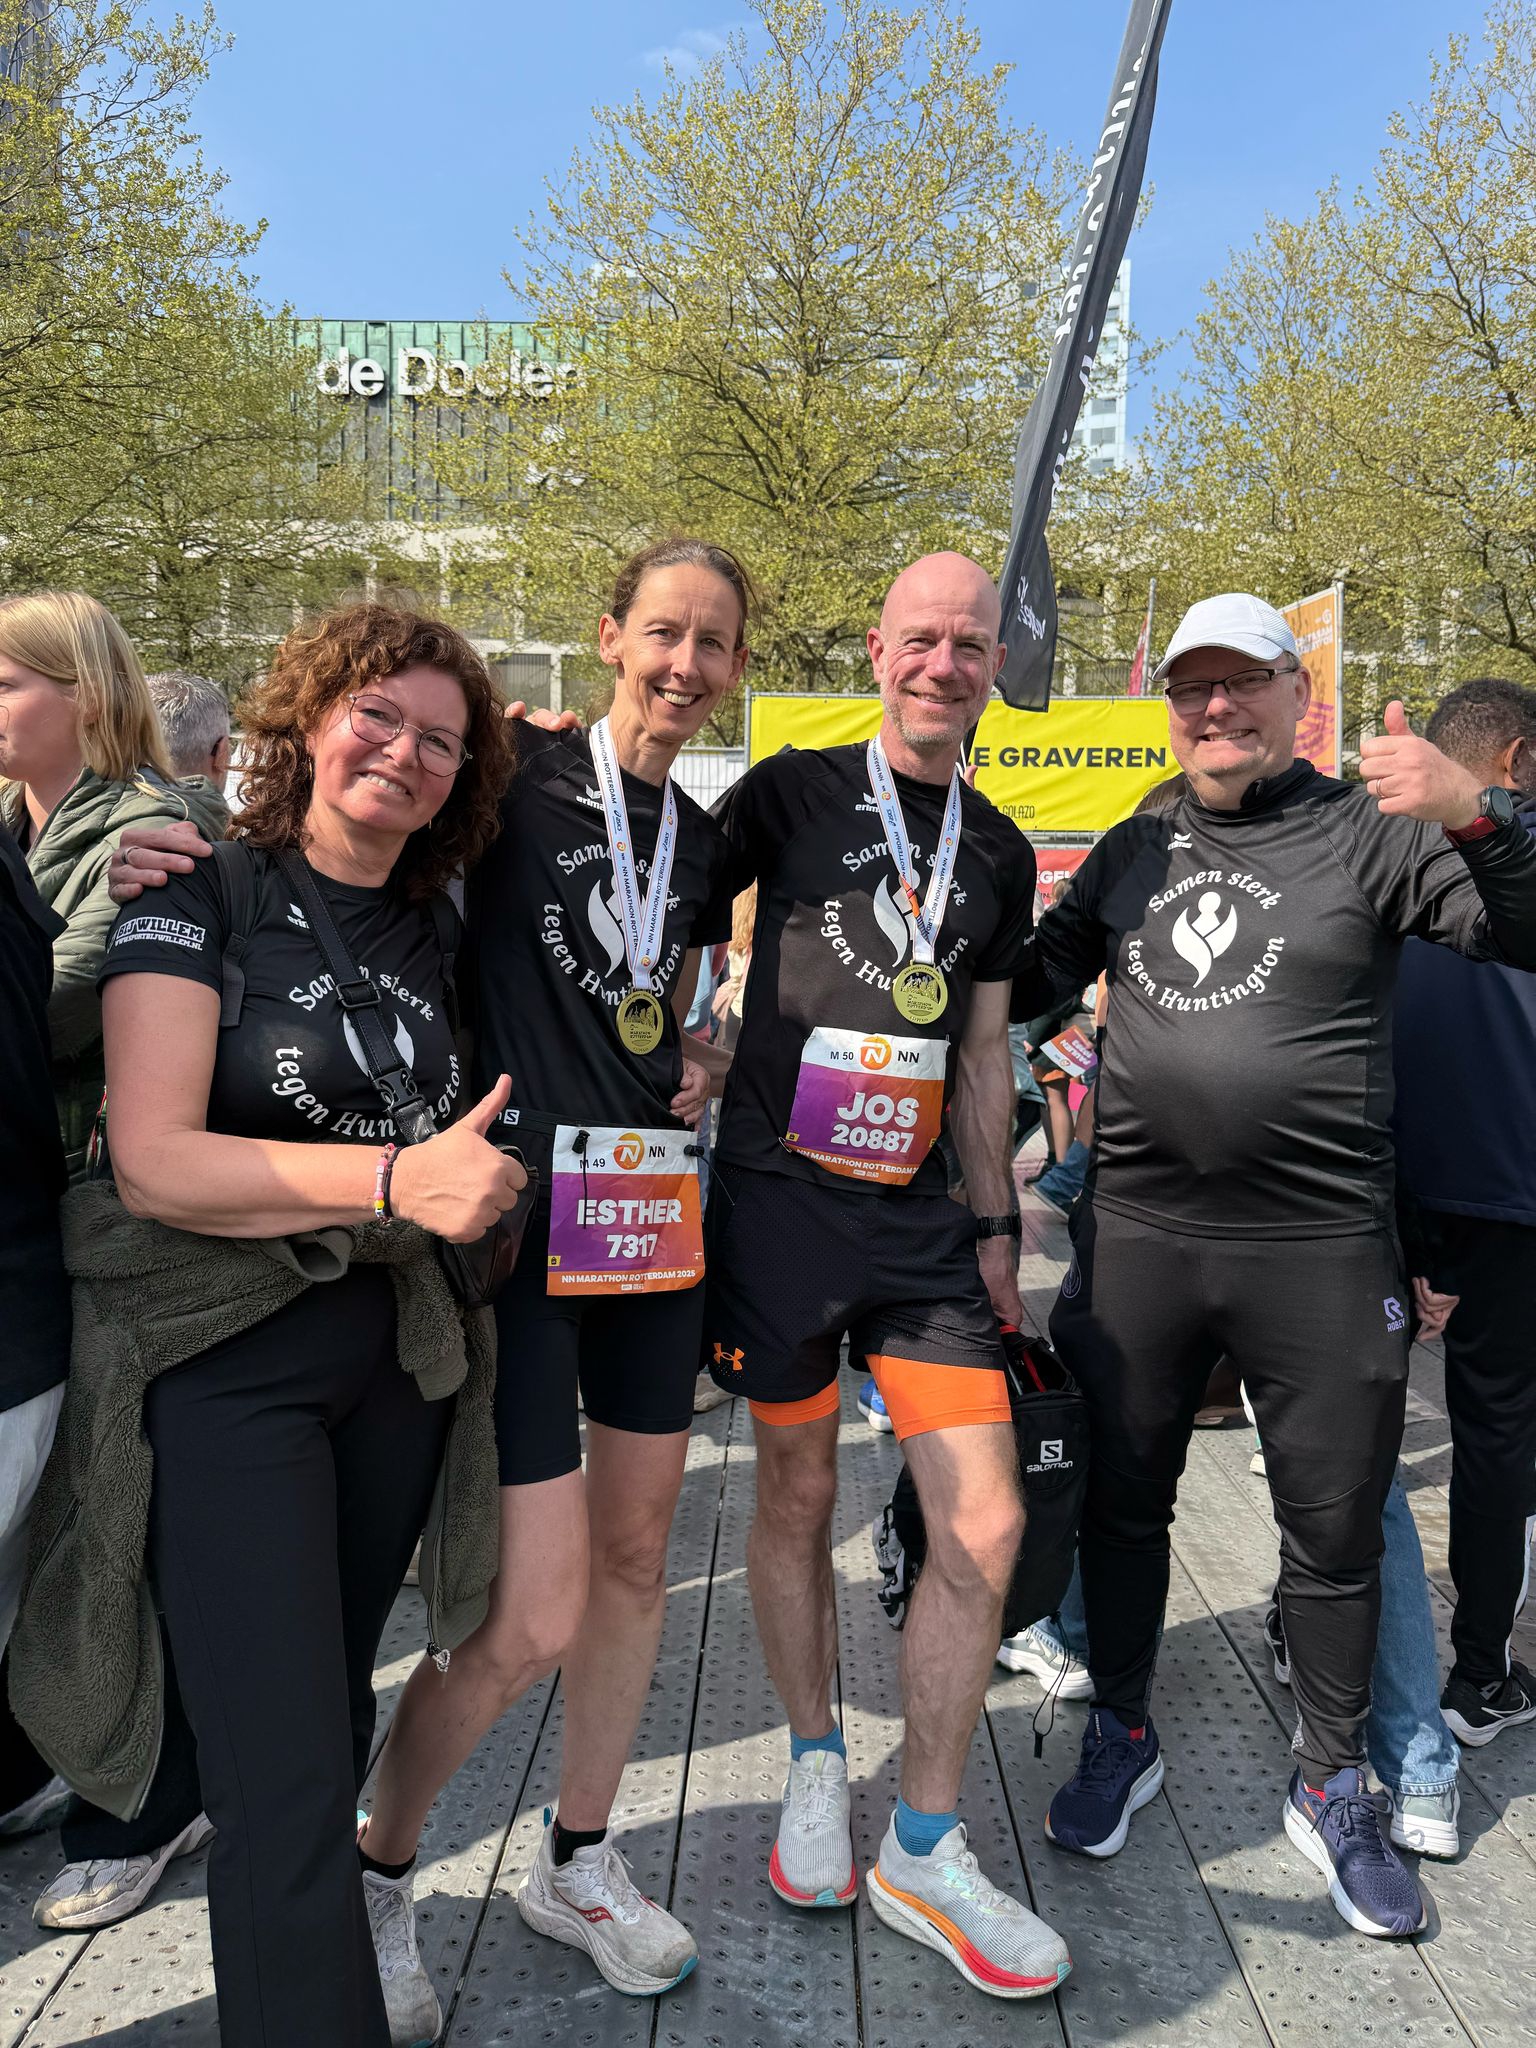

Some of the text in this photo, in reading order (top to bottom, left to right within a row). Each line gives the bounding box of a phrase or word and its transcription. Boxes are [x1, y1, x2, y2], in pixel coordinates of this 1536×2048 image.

[315, 346, 385, 396] de
[999, 747, 1166, 767] GRAVEREN
[604, 762, 617, 804] ROTTERDAM
[855, 803, 880, 814] erim
[1002, 805, 1035, 819] GOLAZO
[842, 841, 921, 872] Samn
[894, 831, 906, 871] ROTTERDAM
[942, 857, 948, 866] NN
[622, 866, 628, 877] NN
[934, 866, 946, 901] MARATHON
[624, 877, 635, 919] MARATHON
[648, 856, 666, 943] NN MARATHON ROTTERDAM
[1148, 870, 1282, 913] Samen sterk
[137, 917, 206, 943] WILLEM
[541, 903, 578, 974] tegen
[820, 899, 856, 965] tegen
[1128, 936, 1285, 1012] tegen Huntington
[288, 965, 434, 1021] Samn sterk
[830, 1051, 854, 1060] M 50
[897, 1050, 920, 1063] NN
[272, 1046, 329, 1125] tegen
[837, 1092, 920, 1128] JOS
[649, 1146, 665, 1158] NN
[830, 1123, 914, 1153] 20887
[579, 1158, 606, 1169] M 49
[811, 1151, 862, 1168] MARATHON
[862, 1161, 913, 1174] ROTTERDAM
[577, 1199, 683, 1225] ESTHER
[606, 1234, 658, 1259] 7317
[561, 1269, 696, 1283] NN MARATHON ROTTERDAM 2025
[1387, 1318, 1405, 1332] ROBEY
